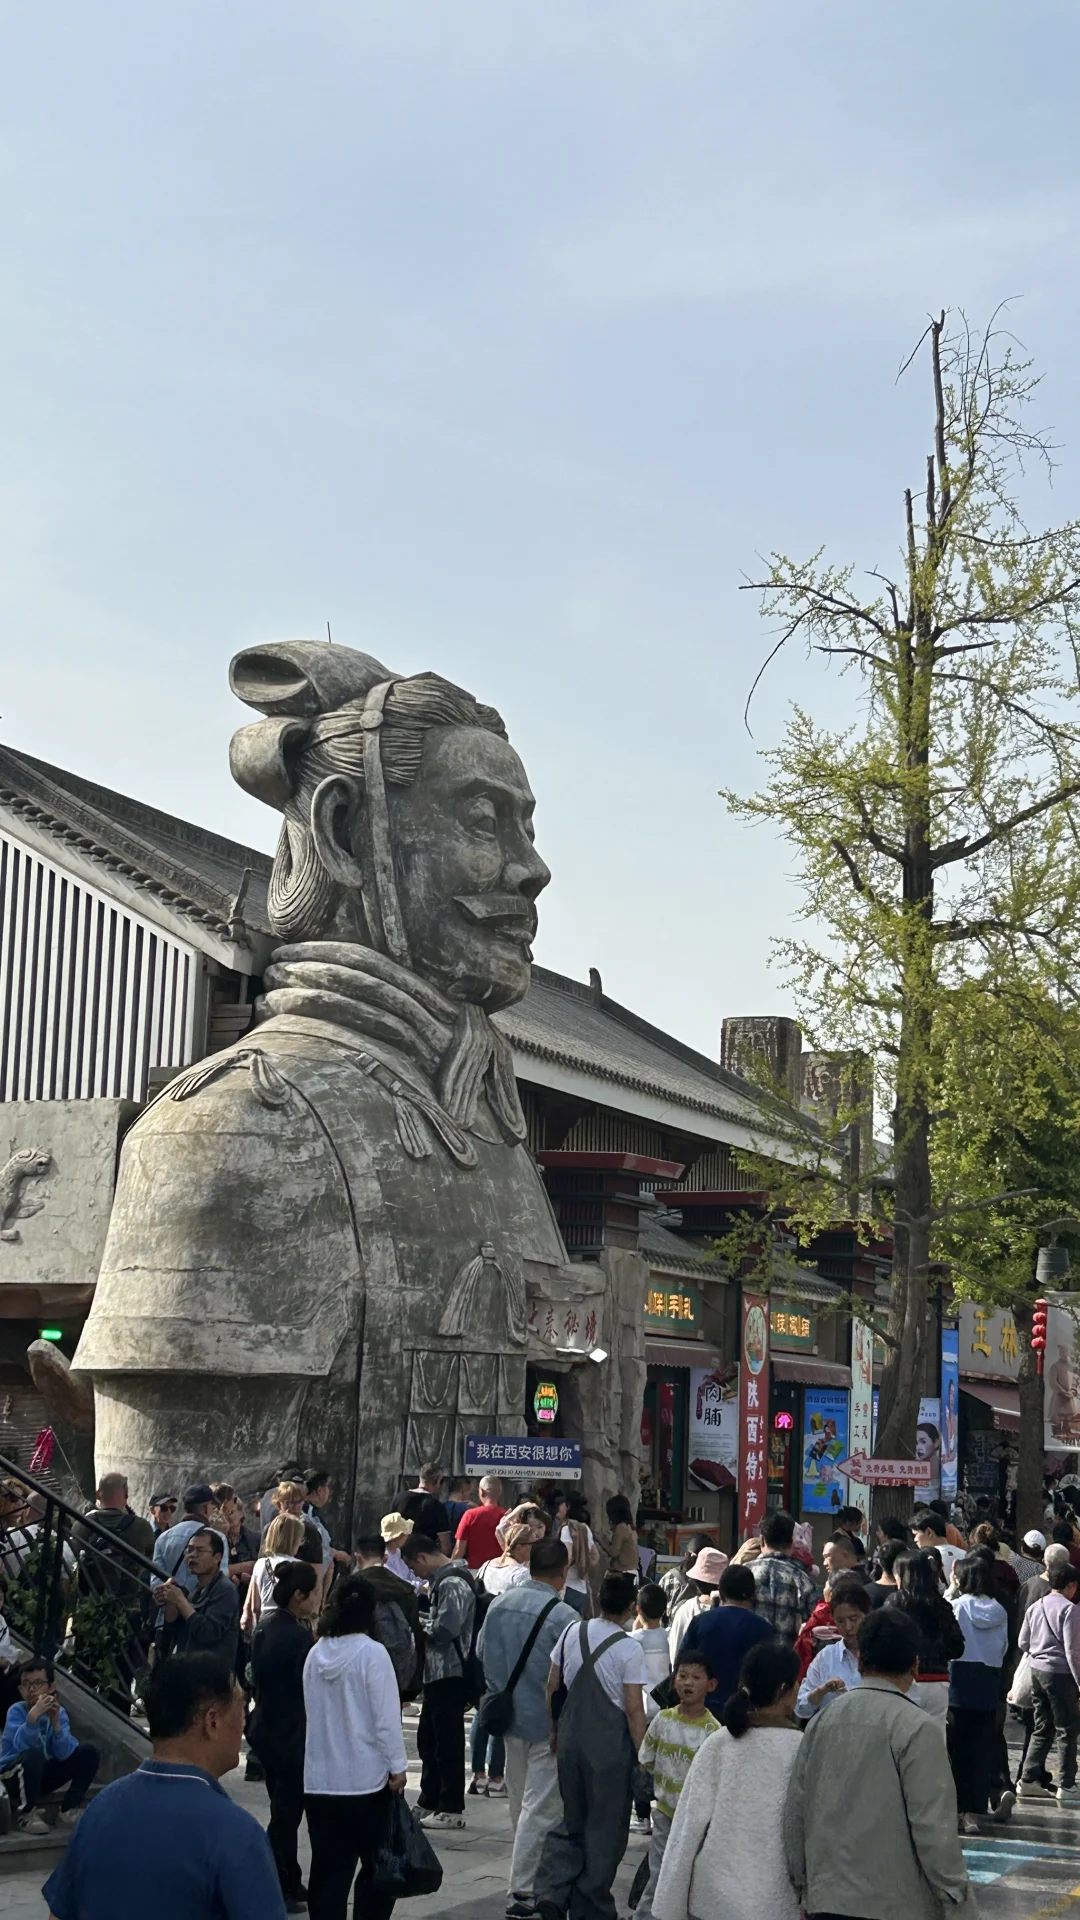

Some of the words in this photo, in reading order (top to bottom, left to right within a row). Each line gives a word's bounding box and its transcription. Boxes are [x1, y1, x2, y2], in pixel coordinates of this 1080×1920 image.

[704, 1383, 722, 1426] 肉脯
[476, 1443, 573, 1461] 我在西安很想你
[745, 1380, 759, 1517] 陕西特产
